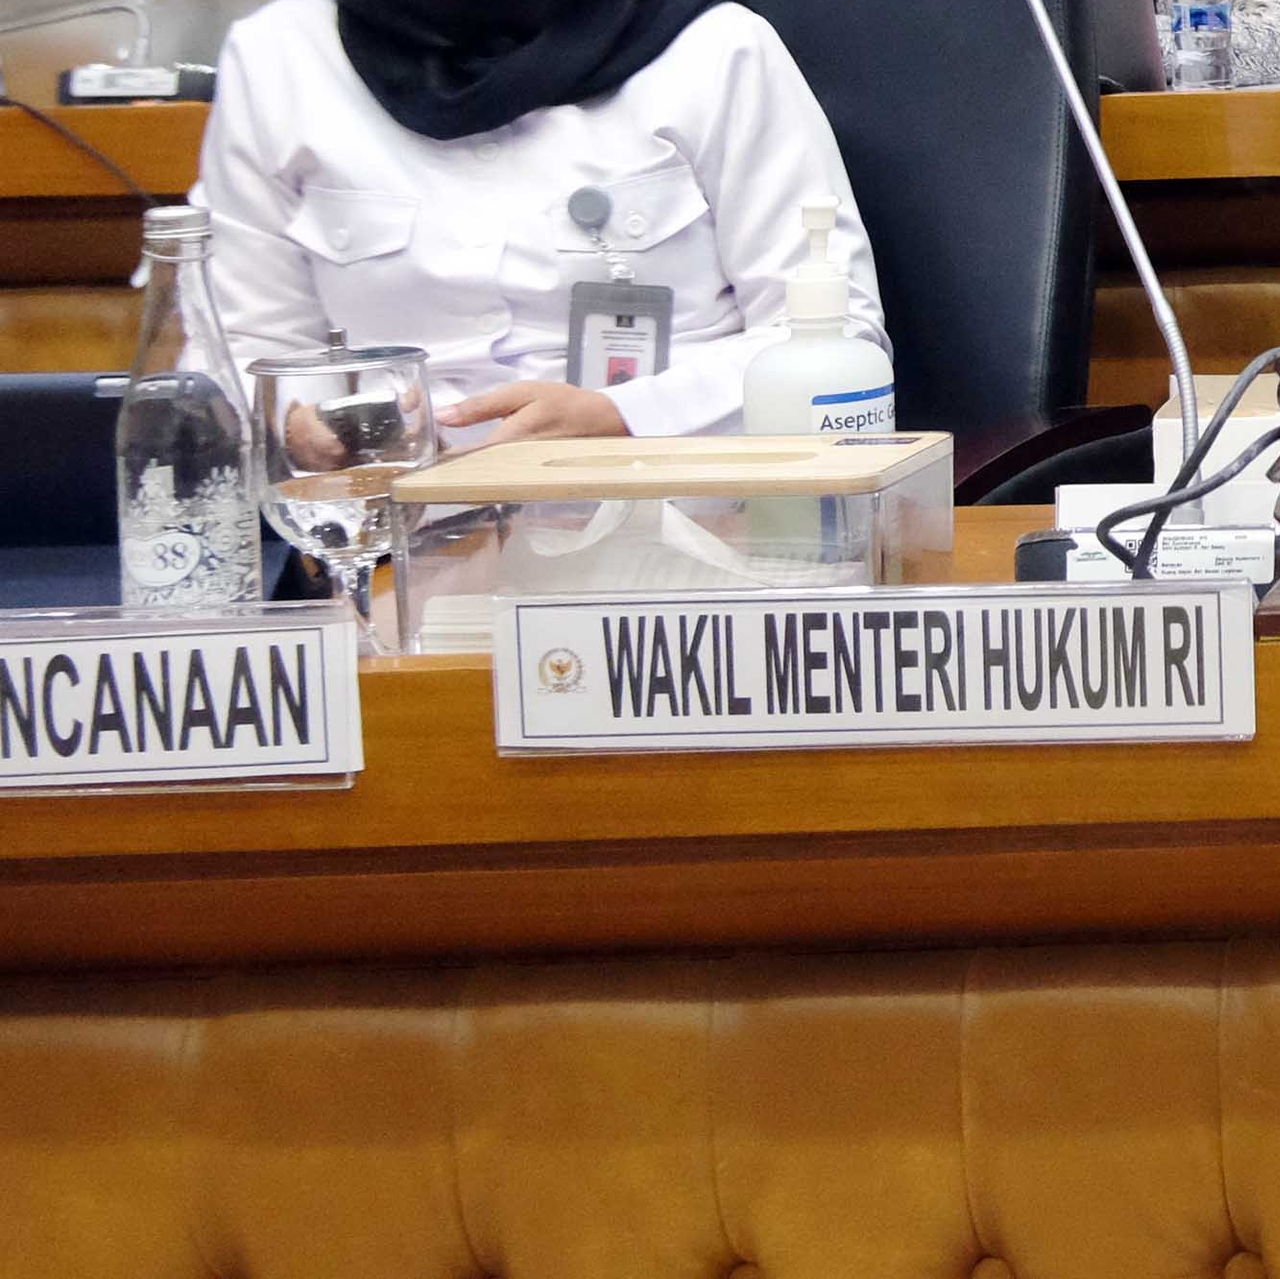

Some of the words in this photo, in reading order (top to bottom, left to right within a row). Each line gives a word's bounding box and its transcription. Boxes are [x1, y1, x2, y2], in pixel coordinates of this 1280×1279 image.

[819, 406, 884, 432] Aseptic
[0, 643, 310, 759] NCANAAN
[601, 613, 752, 718] WAKIL
[763, 609, 967, 716] MENTERI
[981, 606, 1148, 712] HUKUM
[1162, 605, 1206, 707] RI
